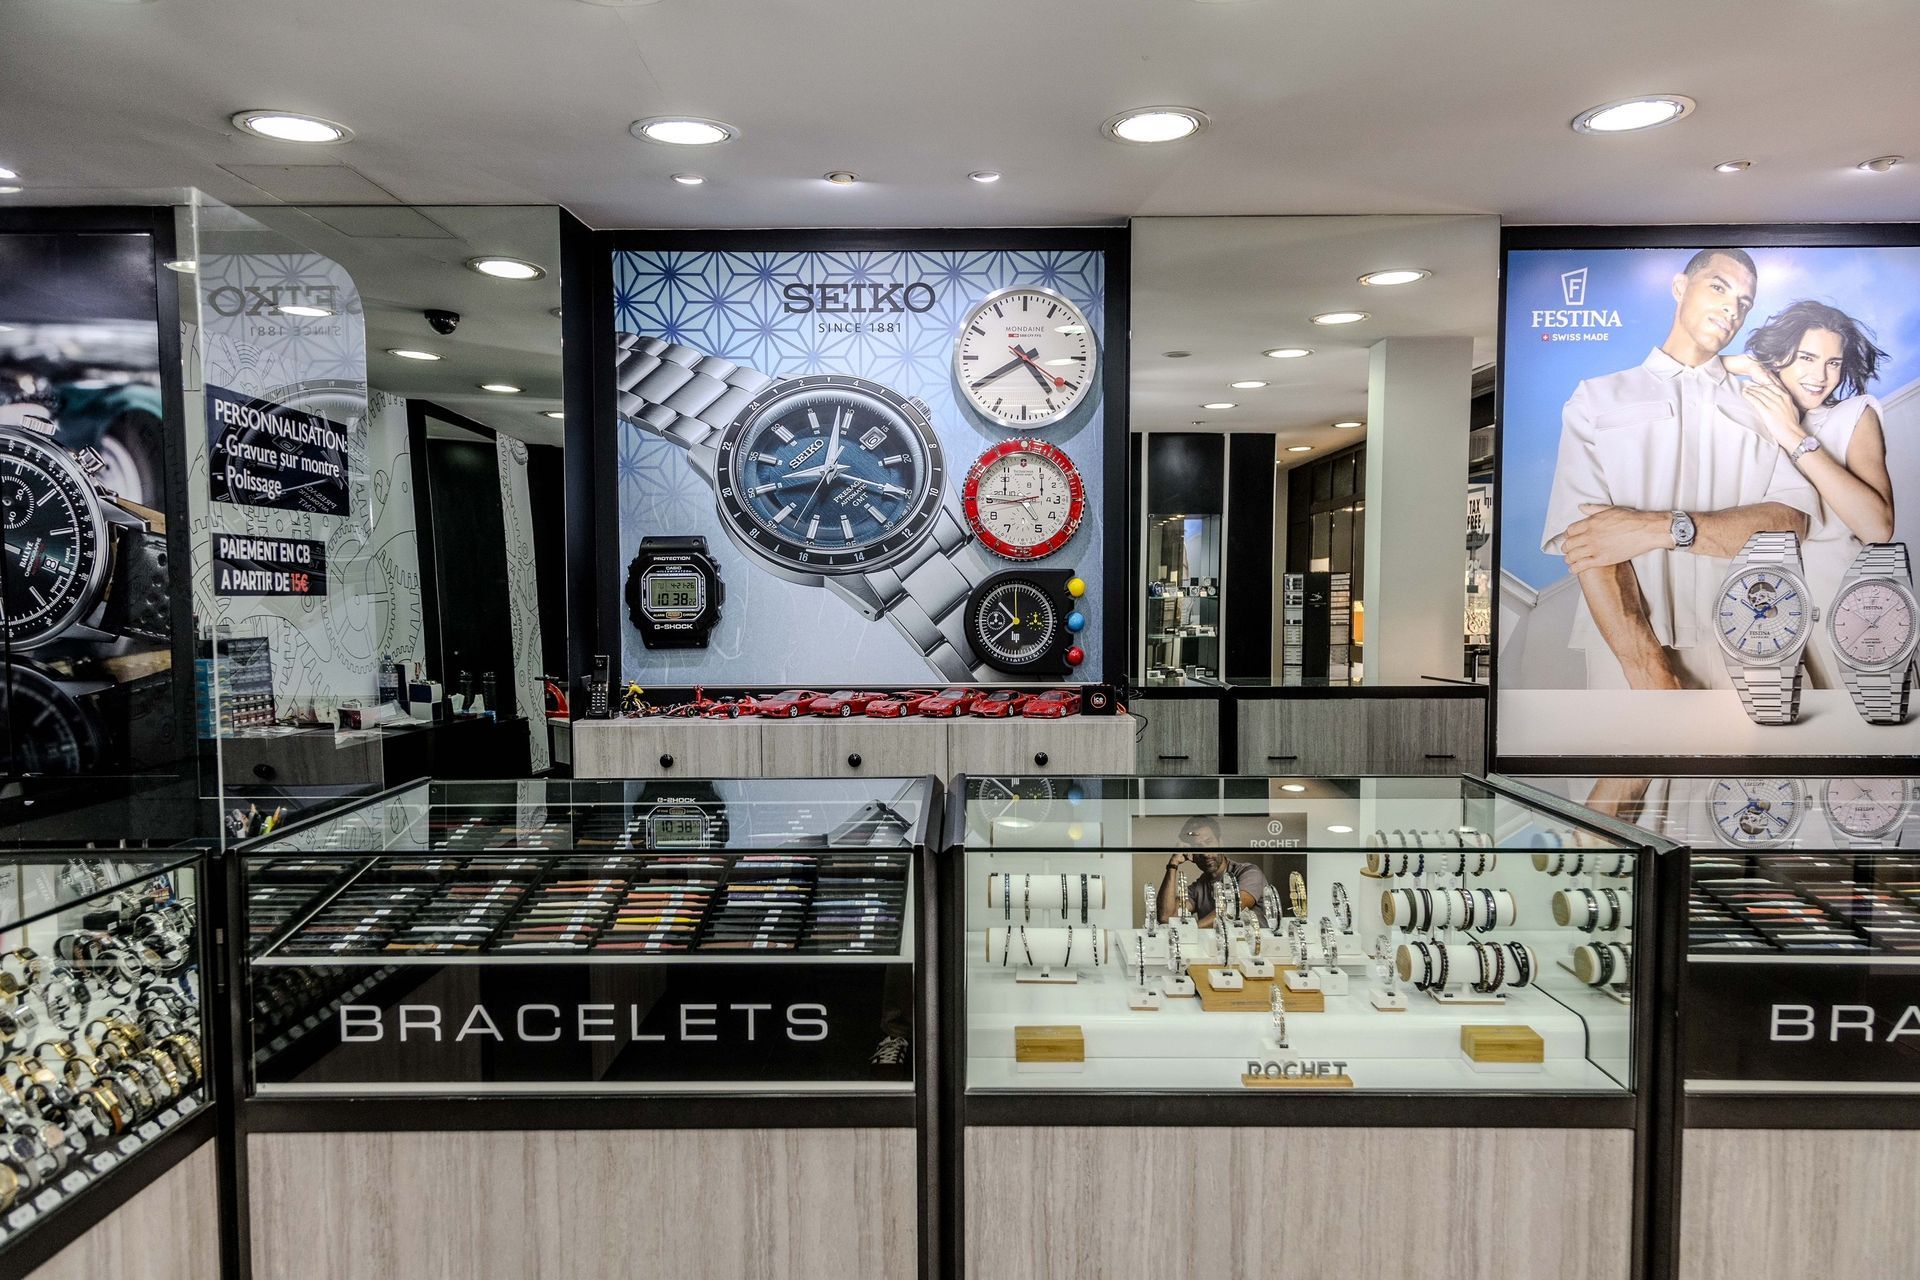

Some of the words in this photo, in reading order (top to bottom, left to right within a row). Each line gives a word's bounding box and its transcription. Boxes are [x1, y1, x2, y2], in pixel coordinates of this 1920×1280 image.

[783, 282, 936, 314] SEIKO
[1531, 310, 1623, 328] FESTINA
[818, 322, 862, 333] SINCE
[870, 322, 902, 333] 1881
[1552, 333, 1581, 341] SWISS
[1583, 333, 1609, 341] MADE
[749, 401, 760, 411] 24
[214, 399, 348, 453] PERSONNALISATION:
[722, 441, 733, 451] 22
[226, 434, 277, 465] Gravure
[280, 452, 299, 469] sur
[301, 457, 340, 478] montre
[789, 439, 824, 469] SEIKO
[227, 465, 282, 499] Polissage
[15, 489, 25, 501] 20
[722, 487, 733, 498] 20
[833, 480, 863, 503] PRESAG
[929, 487, 939, 497] 10
[852, 492, 869, 507] GMT
[1053, 495, 1061, 504] 3
[1469, 499, 1481, 515] TAX
[8, 511, 17, 522] 40
[990, 511, 998, 521] 8
[1048, 511, 1056, 520] 4
[1467, 514, 1481, 530] FREE
[749, 528, 760, 539] 18
[901, 528, 913, 539] 12
[1003, 524, 1011, 533] 7
[1034, 524, 1043, 533] 5
[19, 541, 34, 568] RALLYE
[220, 538, 278, 560] PAIEMENT
[280, 543, 294, 562] EN
[296, 544, 311, 564] CB
[799, 552, 809, 562] 16
[853, 552, 865, 562] 14
[221, 569, 232, 590] A
[233, 570, 273, 591] PARTIR
[275, 572, 290, 592] DE
[291, 573, 310, 593] 15€
[1250, 839, 1300, 848] ROCHET
[340, 1003, 829, 1043] BRACELETS
[1247, 1060, 1348, 1079] ROCHET
